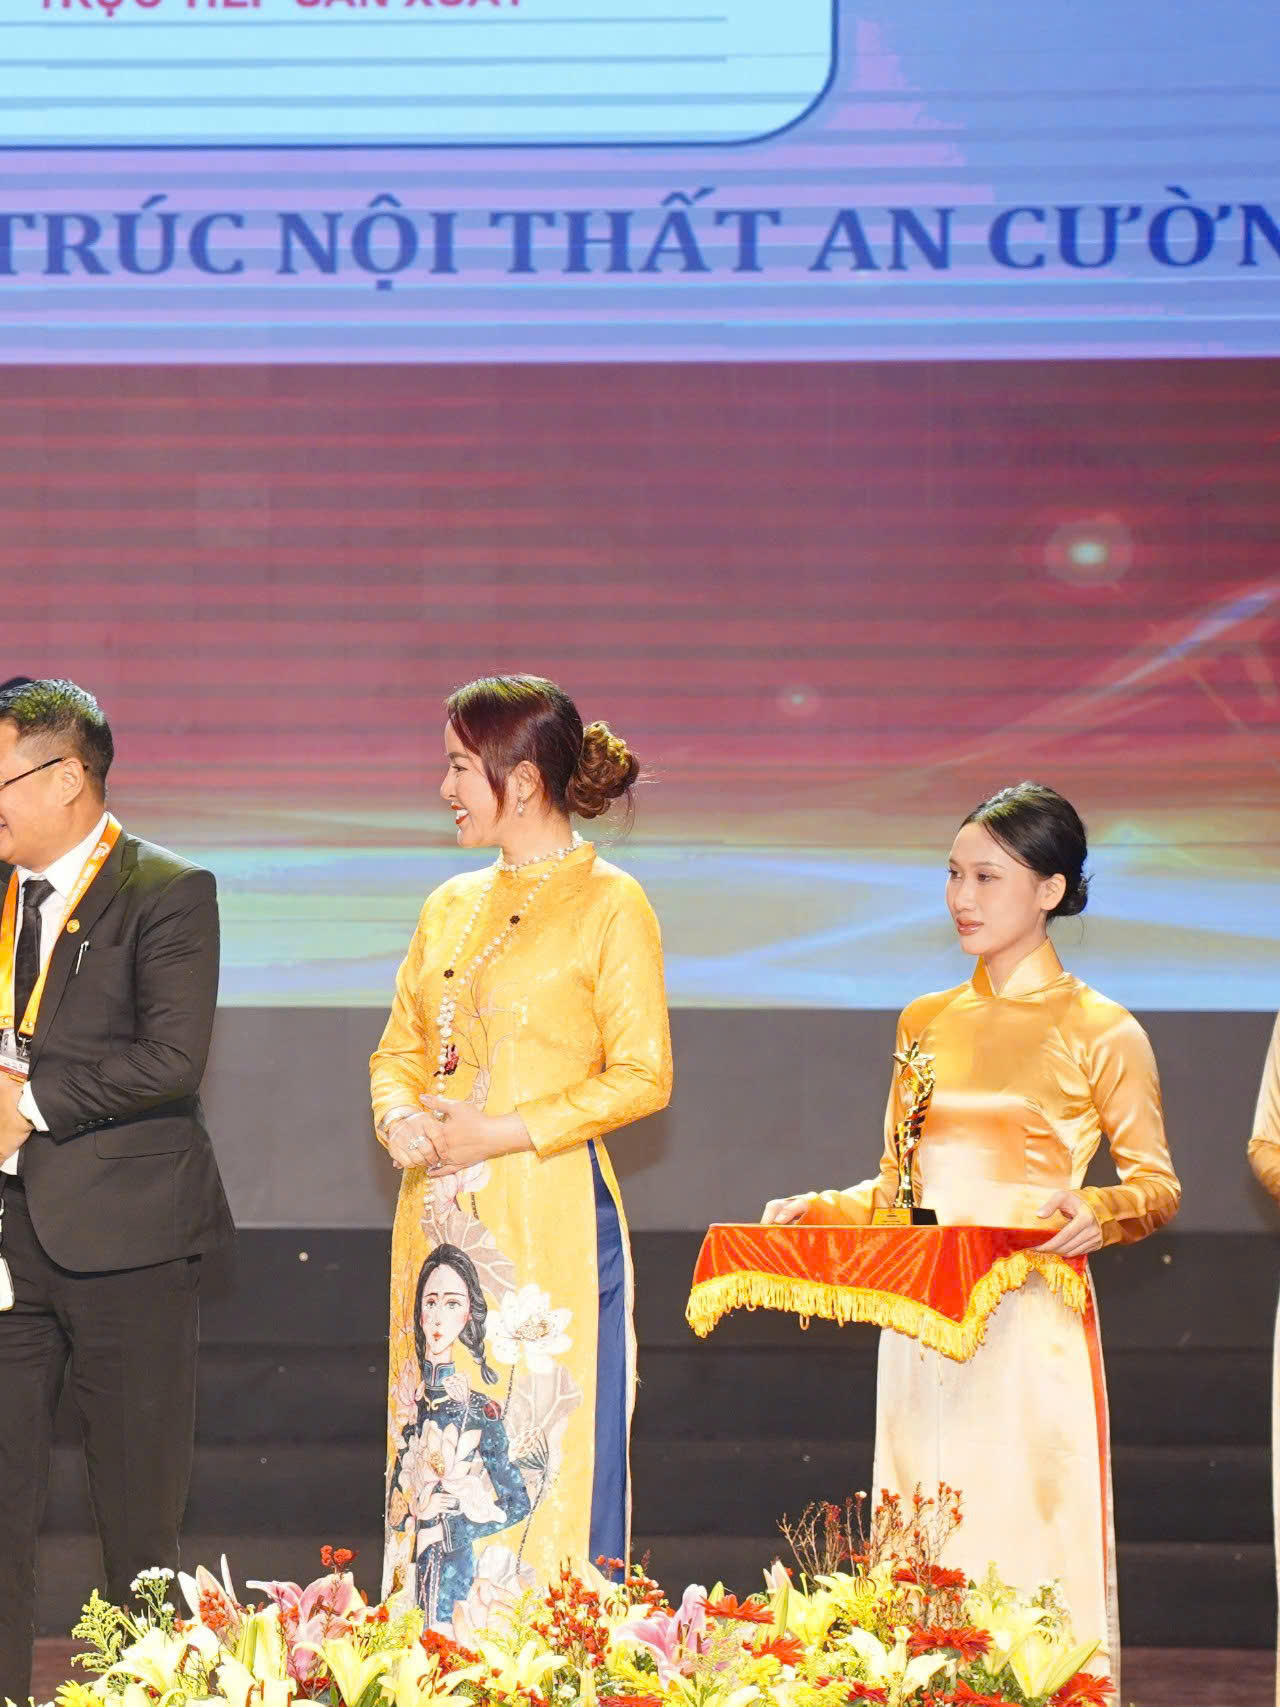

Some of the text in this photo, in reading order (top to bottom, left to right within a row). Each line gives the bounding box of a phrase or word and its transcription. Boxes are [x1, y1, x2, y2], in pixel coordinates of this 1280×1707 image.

[276, 193, 458, 291] NỘI
[488, 186, 782, 275] THẤT
[808, 207, 957, 273] AN
